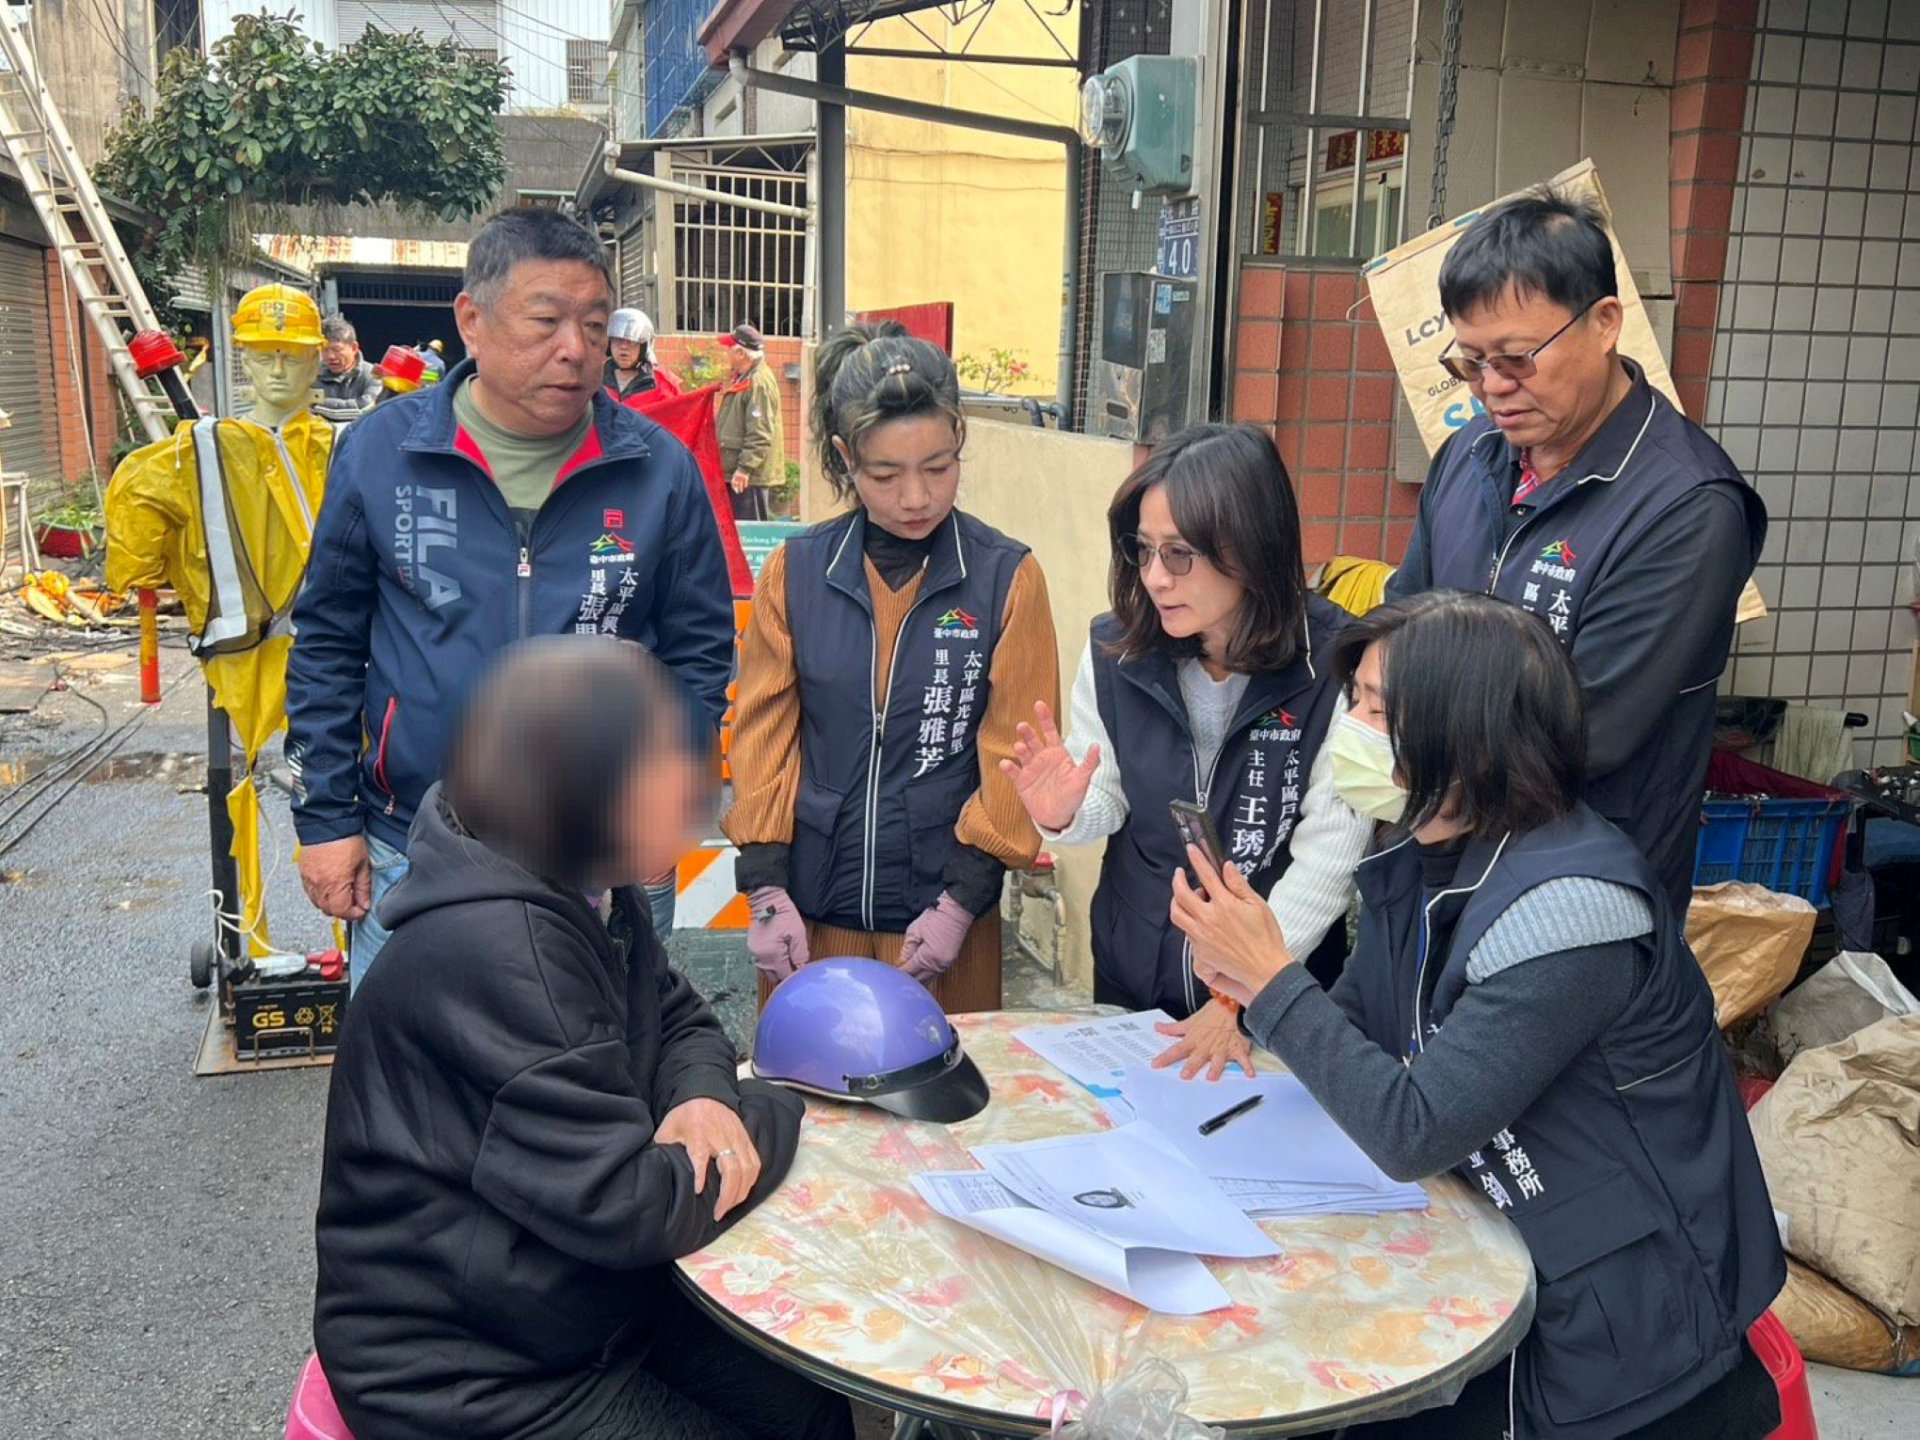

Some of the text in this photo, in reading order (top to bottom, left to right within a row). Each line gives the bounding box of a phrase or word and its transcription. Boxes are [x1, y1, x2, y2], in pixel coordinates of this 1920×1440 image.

[1168, 238, 1191, 275] 40
[1405, 311, 1446, 346] LCY
[395, 485, 414, 564] SPORT
[416, 486, 462, 610] FILA
[601, 567, 639, 640] 太平區興
[1522, 581, 1541, 612] 區
[1548, 589, 1572, 644] 太平
[252, 1011, 286, 1029] GS
